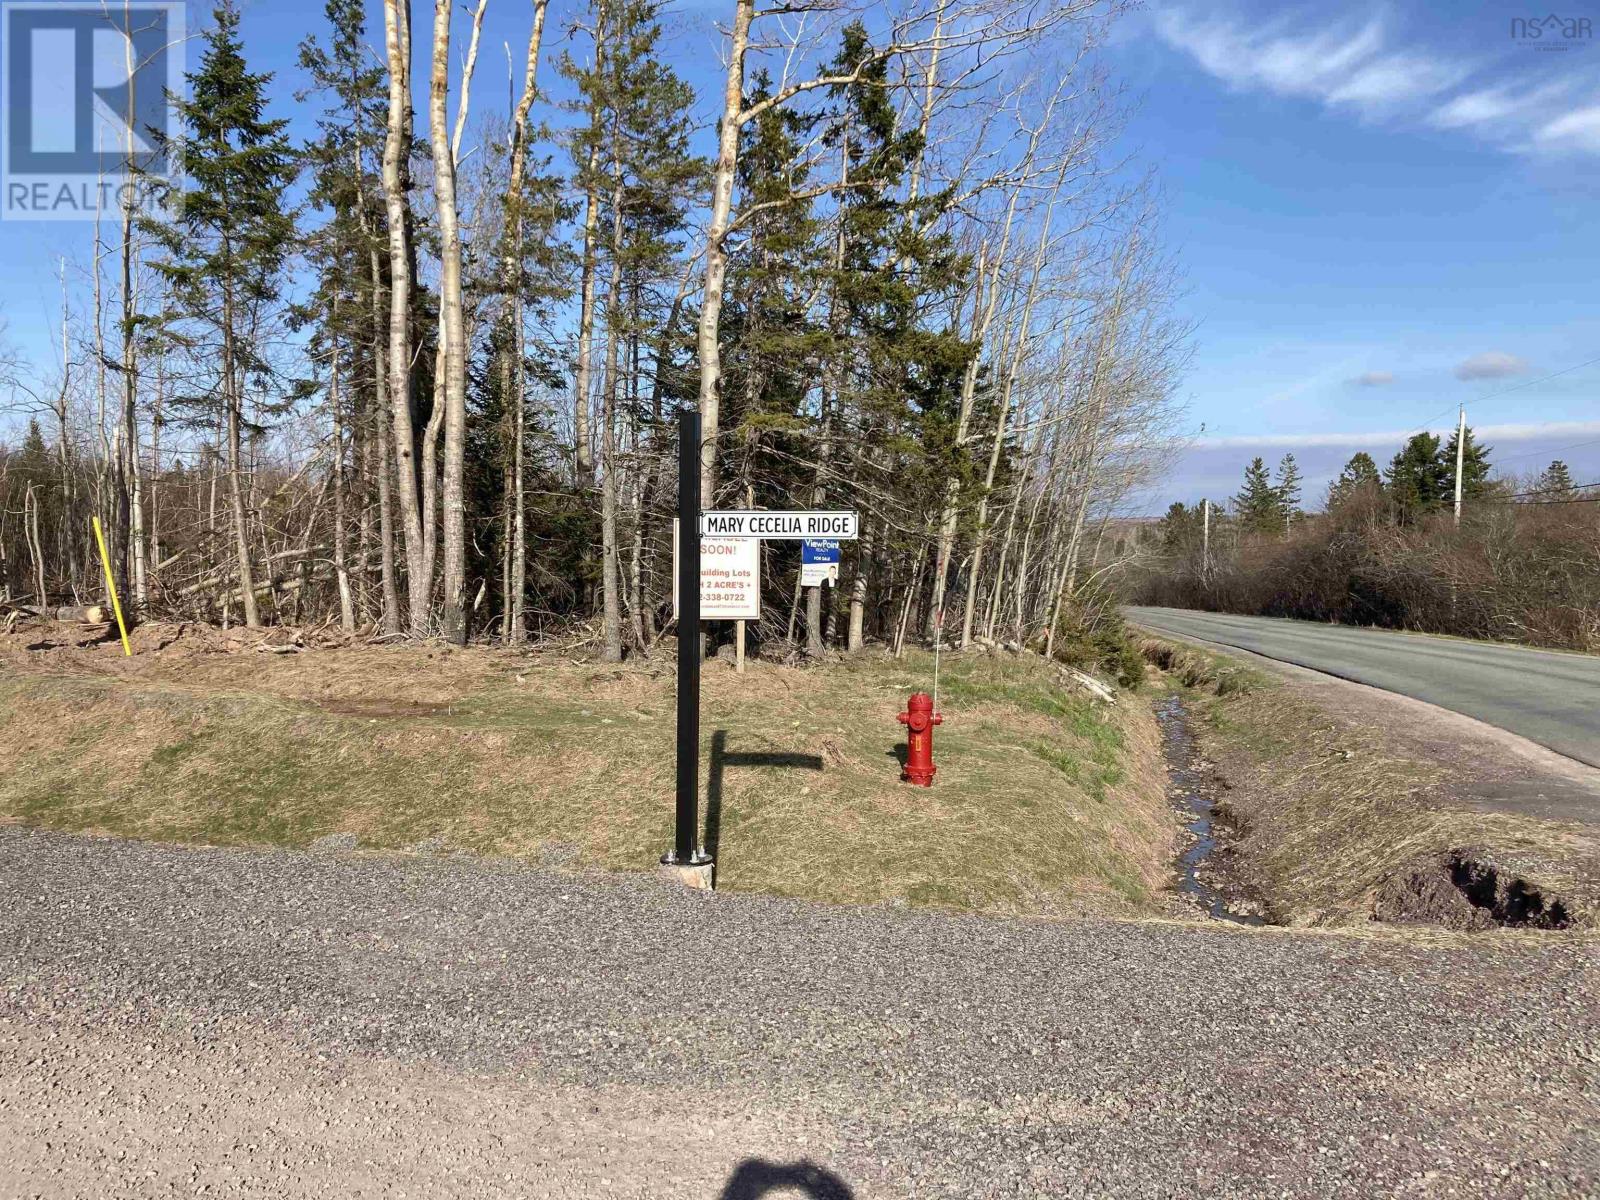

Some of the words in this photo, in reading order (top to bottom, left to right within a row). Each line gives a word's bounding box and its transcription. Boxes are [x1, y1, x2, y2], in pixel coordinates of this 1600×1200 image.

[707, 517, 745, 533] MARY
[749, 517, 802, 533] CECELIA
[808, 517, 849, 533] RIDGE
[804, 539, 839, 549] ViewPoint
[700, 544, 736, 555] SOON!
[700, 568, 730, 578] uilding
[732, 569, 751, 577] Lots
[706, 581, 712, 589] 2
[714, 581, 744, 589] ACRE'S
[700, 593, 745, 601] 2-338-0722
